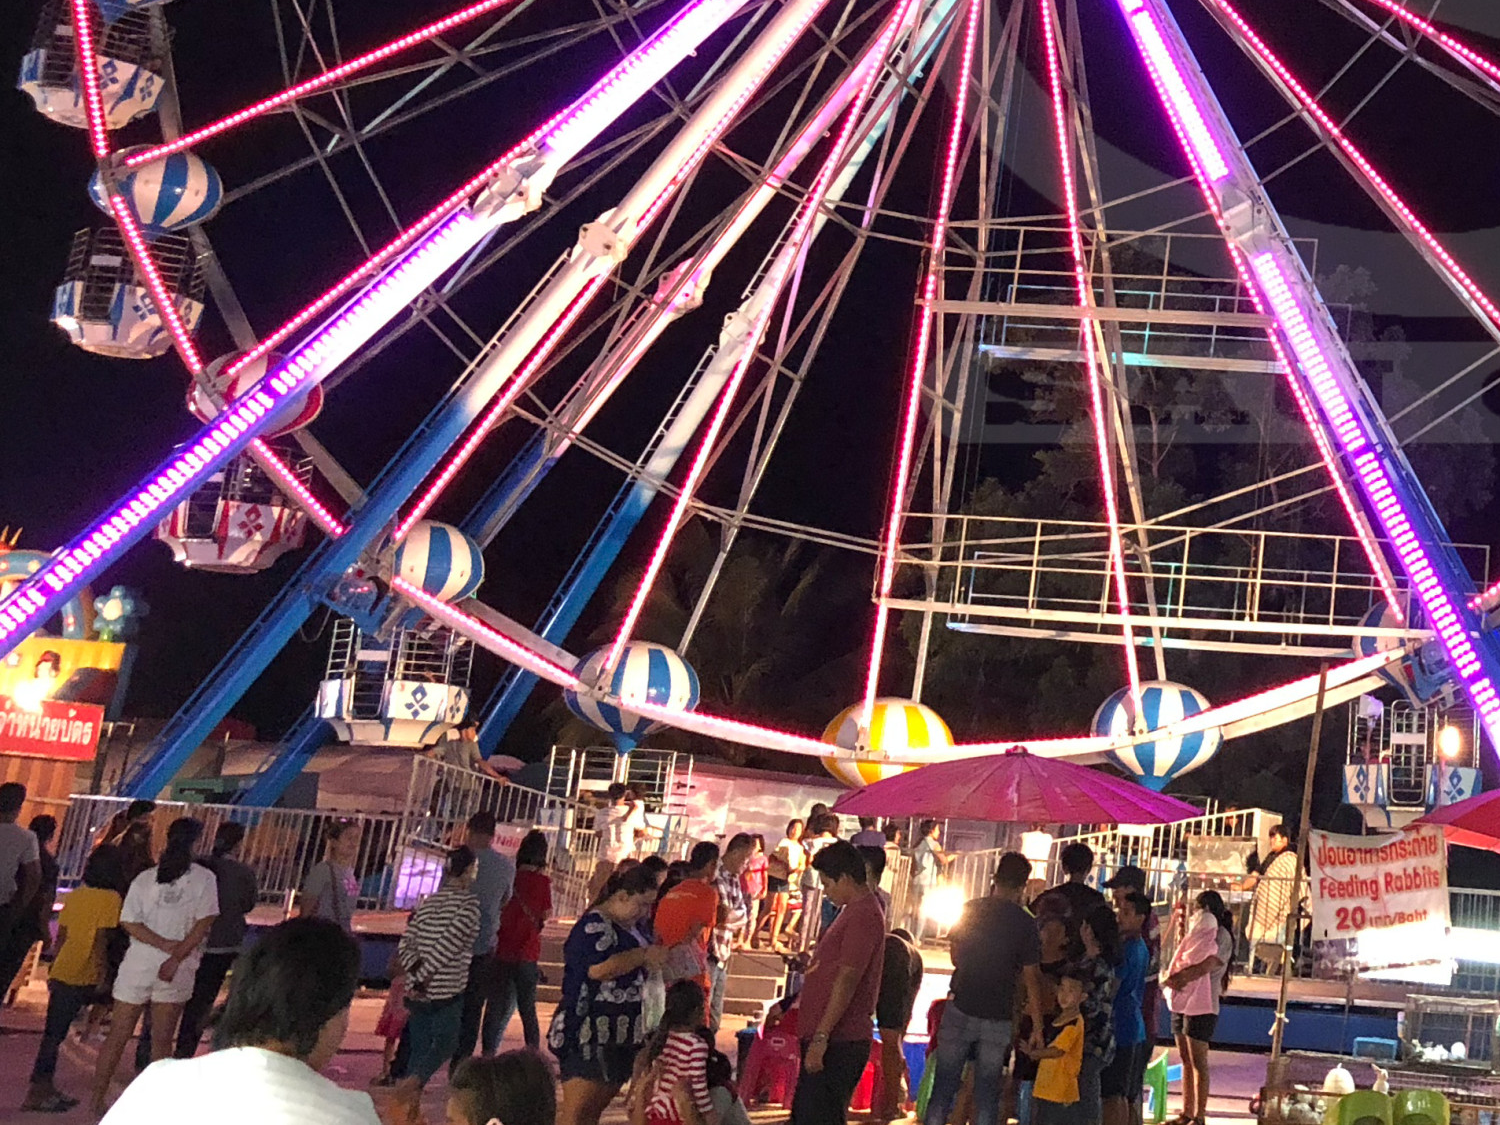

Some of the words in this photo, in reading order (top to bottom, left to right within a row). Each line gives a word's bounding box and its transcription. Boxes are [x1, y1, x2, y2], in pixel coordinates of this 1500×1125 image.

[1319, 874, 1380, 901] Feeding
[1383, 866, 1440, 894] Rabbits
[1335, 906, 1366, 931] 20
